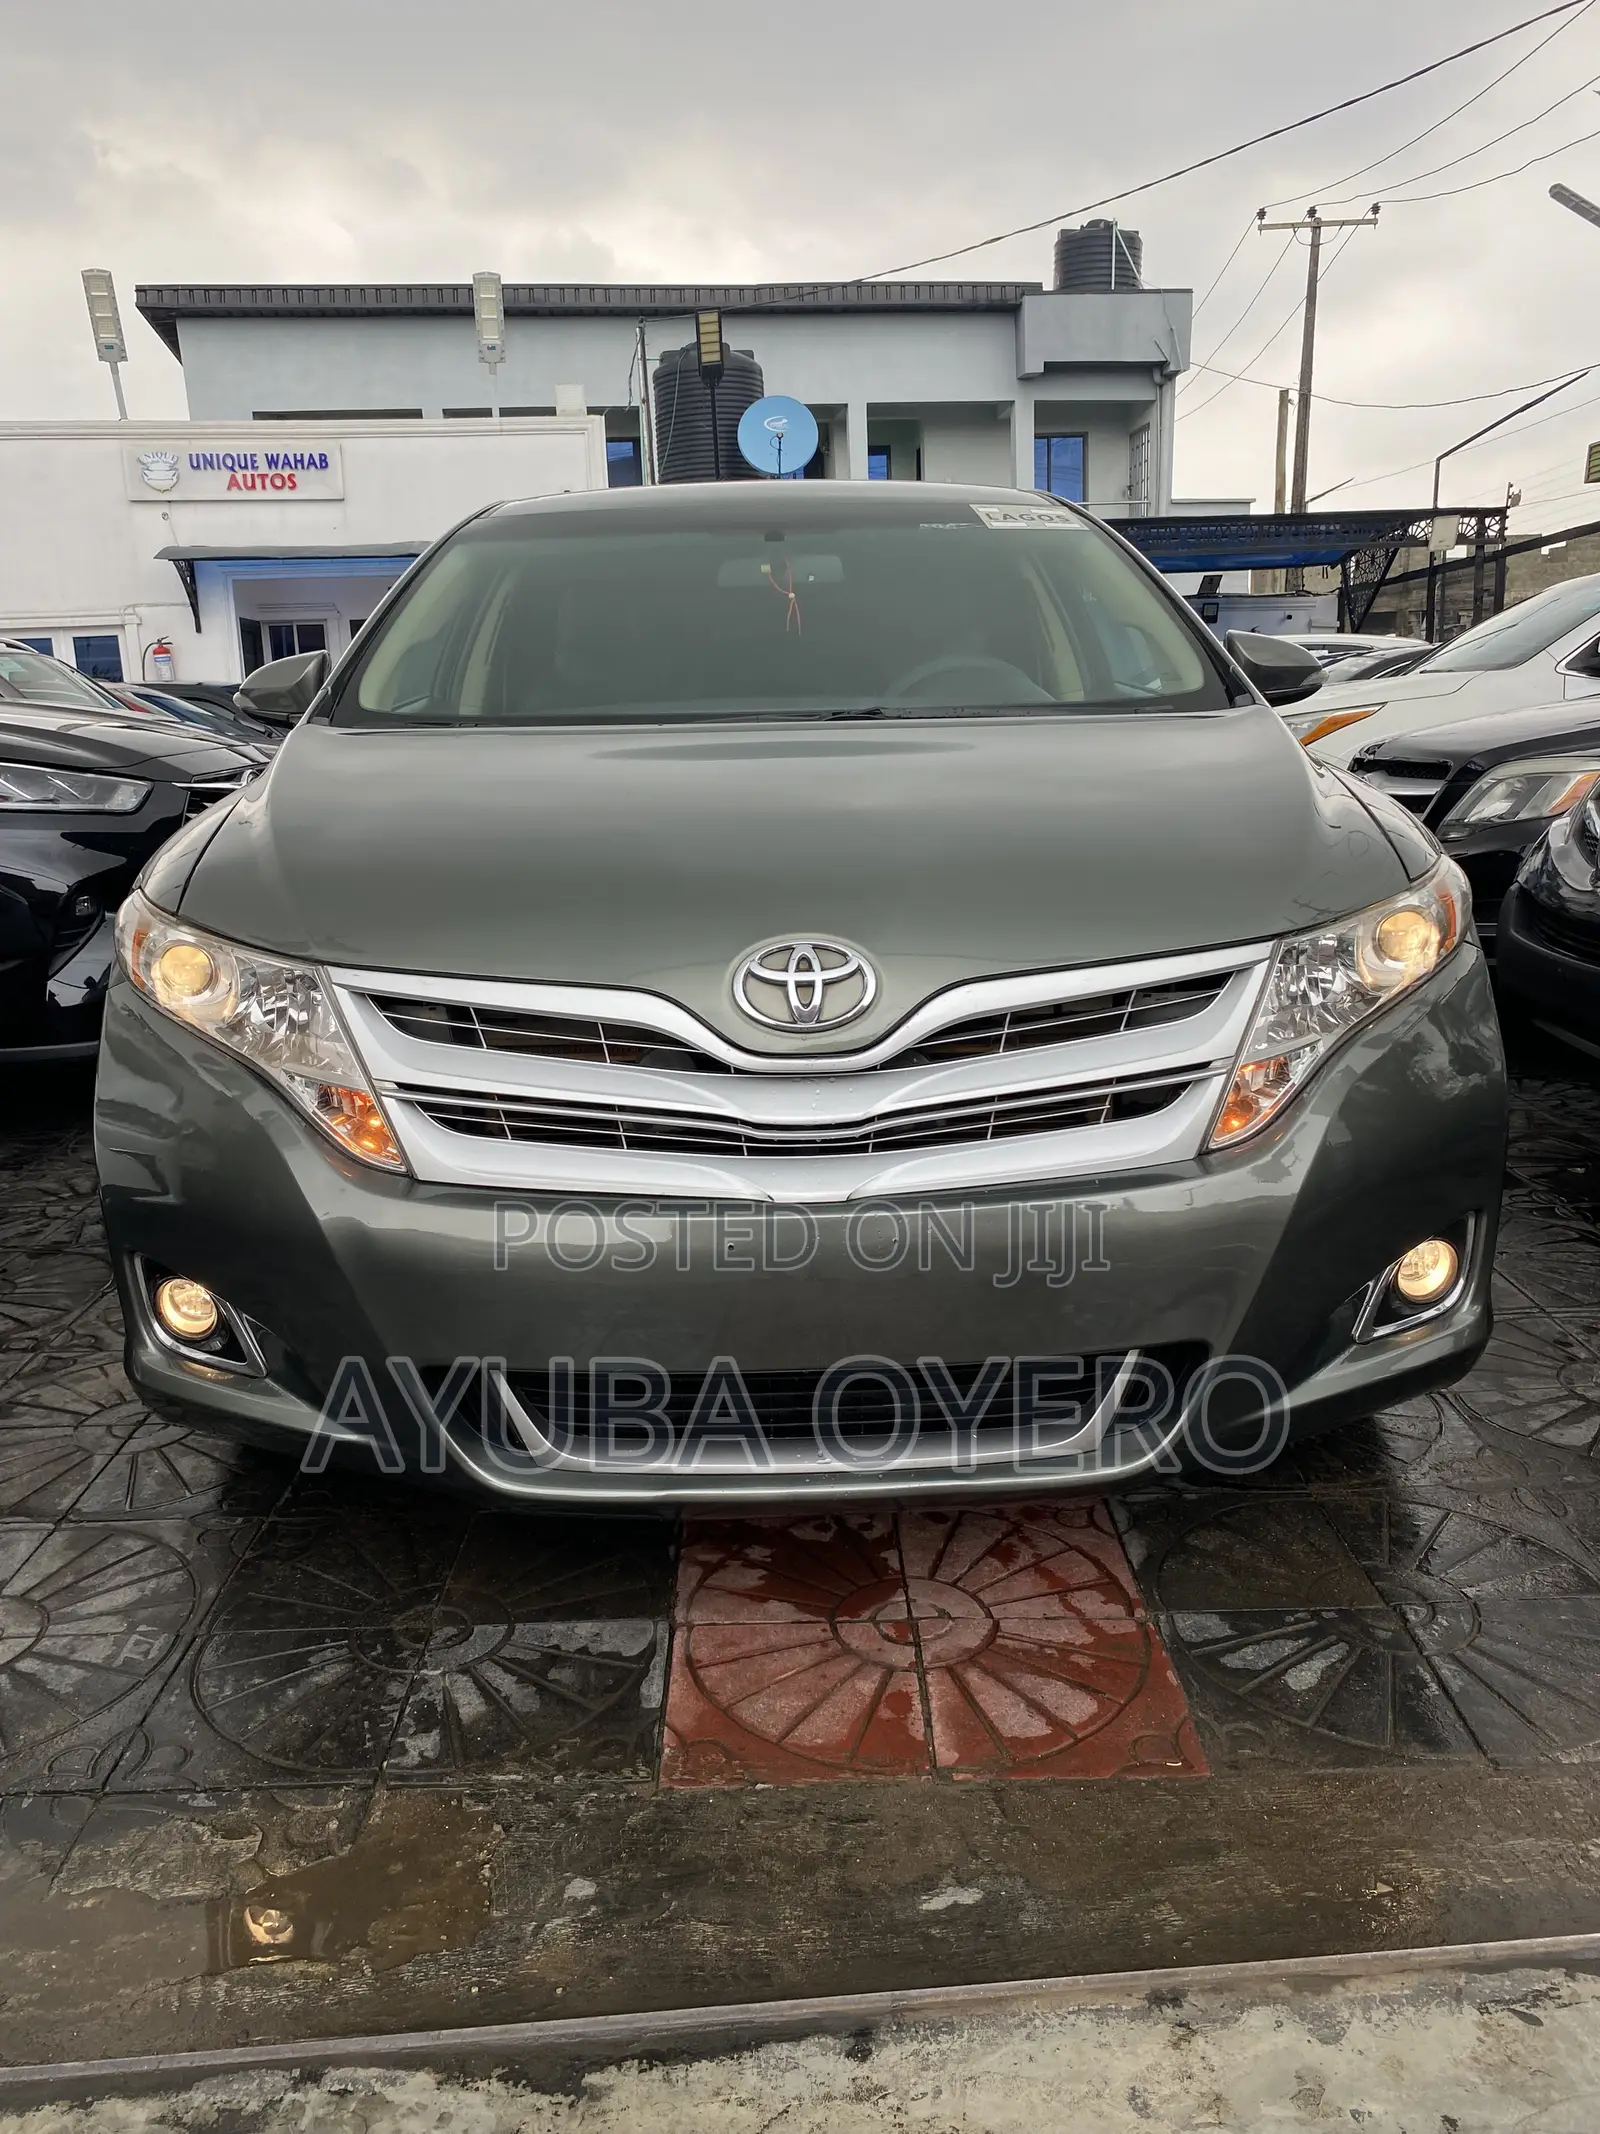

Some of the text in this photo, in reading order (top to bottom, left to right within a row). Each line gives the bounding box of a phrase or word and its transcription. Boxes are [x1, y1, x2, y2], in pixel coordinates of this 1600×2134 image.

[188, 453, 329, 473] UNIQUE WAHAB
[226, 473, 298, 491] AUTOS
[985, 512, 1071, 523] LAGOS
